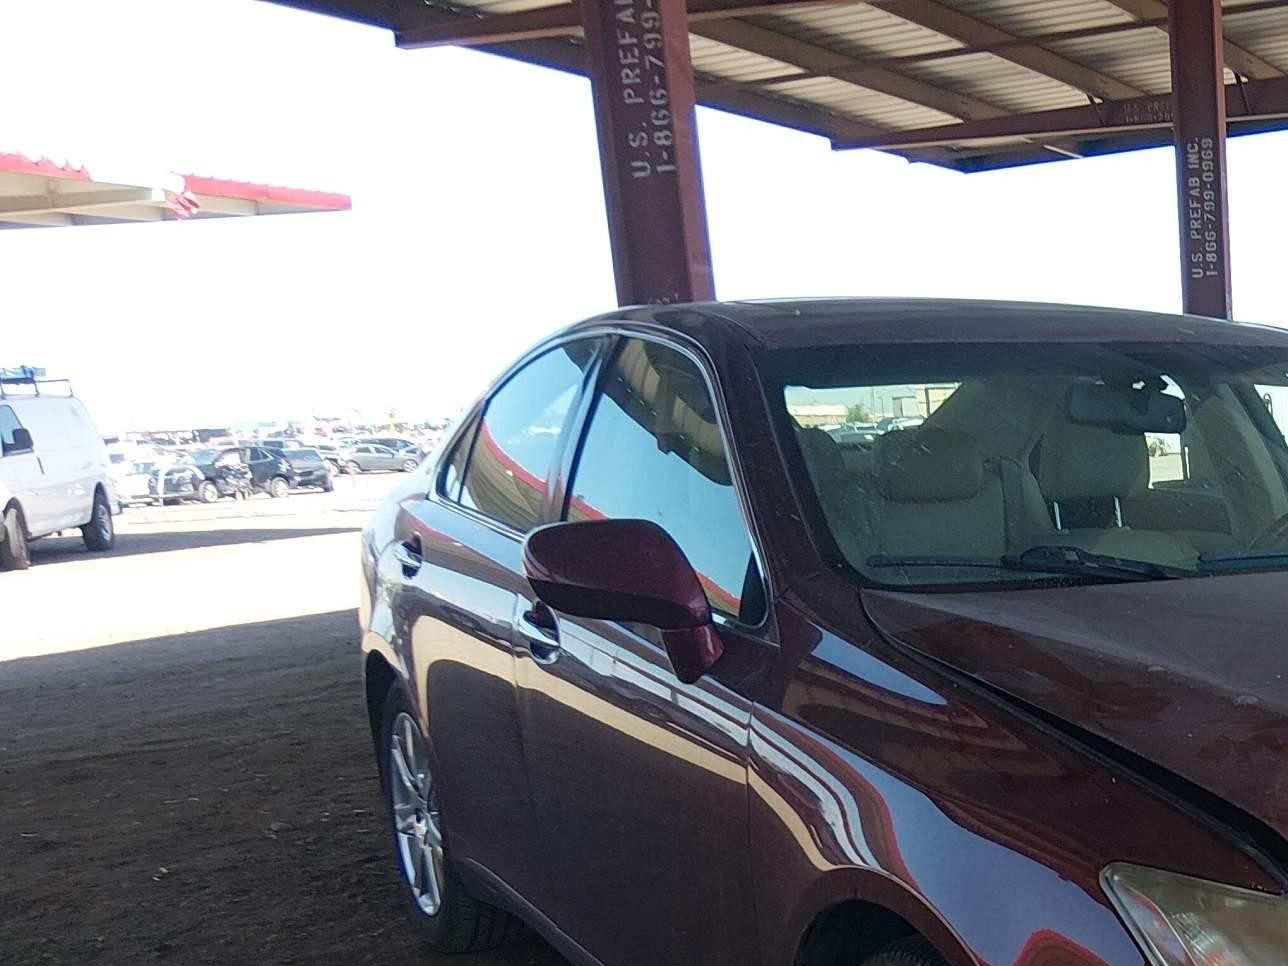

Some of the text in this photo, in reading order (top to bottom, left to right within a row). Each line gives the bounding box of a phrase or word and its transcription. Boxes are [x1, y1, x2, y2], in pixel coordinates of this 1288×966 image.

[628, 121, 652, 178] U.S.
[1186, 137, 1204, 278] U.S. PREFAB INC.
[1201, 137, 1218, 276] 1-866-799-0969
